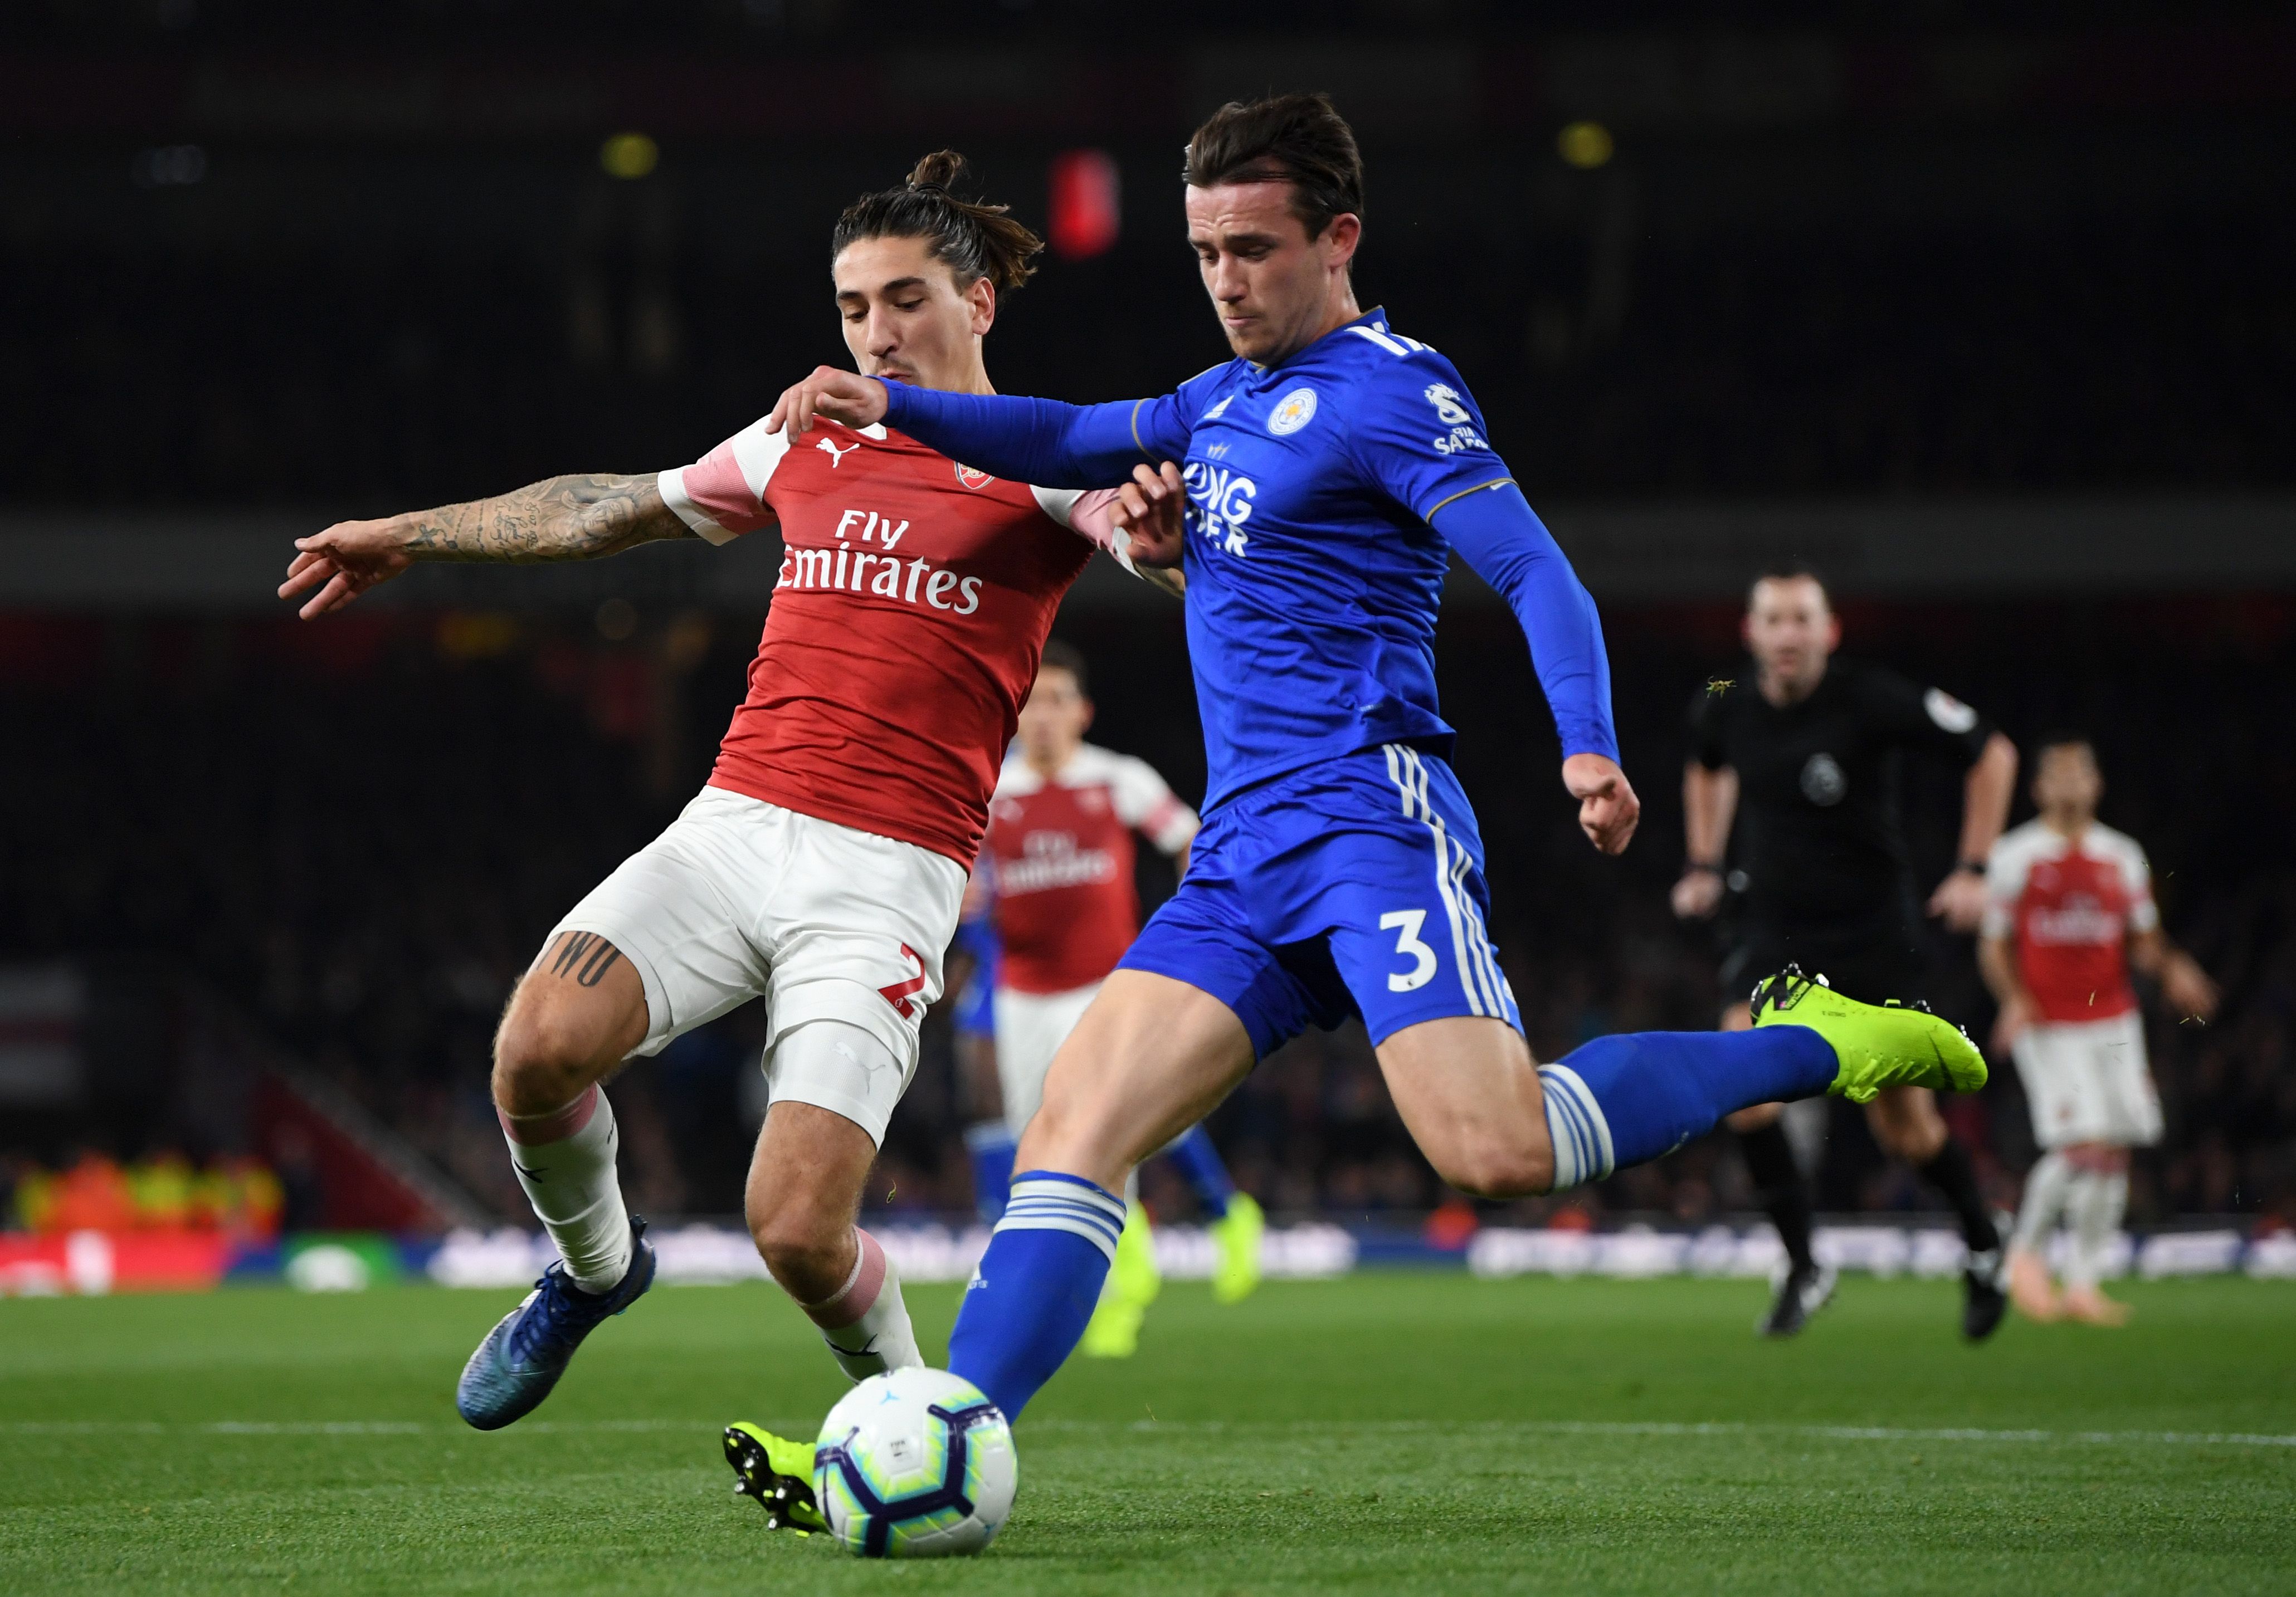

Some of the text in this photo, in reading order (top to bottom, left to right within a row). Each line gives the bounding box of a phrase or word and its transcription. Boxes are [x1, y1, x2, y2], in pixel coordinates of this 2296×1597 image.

[835, 509, 909, 550] Fly
[878, 942, 925, 1020] 2
[1379, 909, 1437, 992] 3
